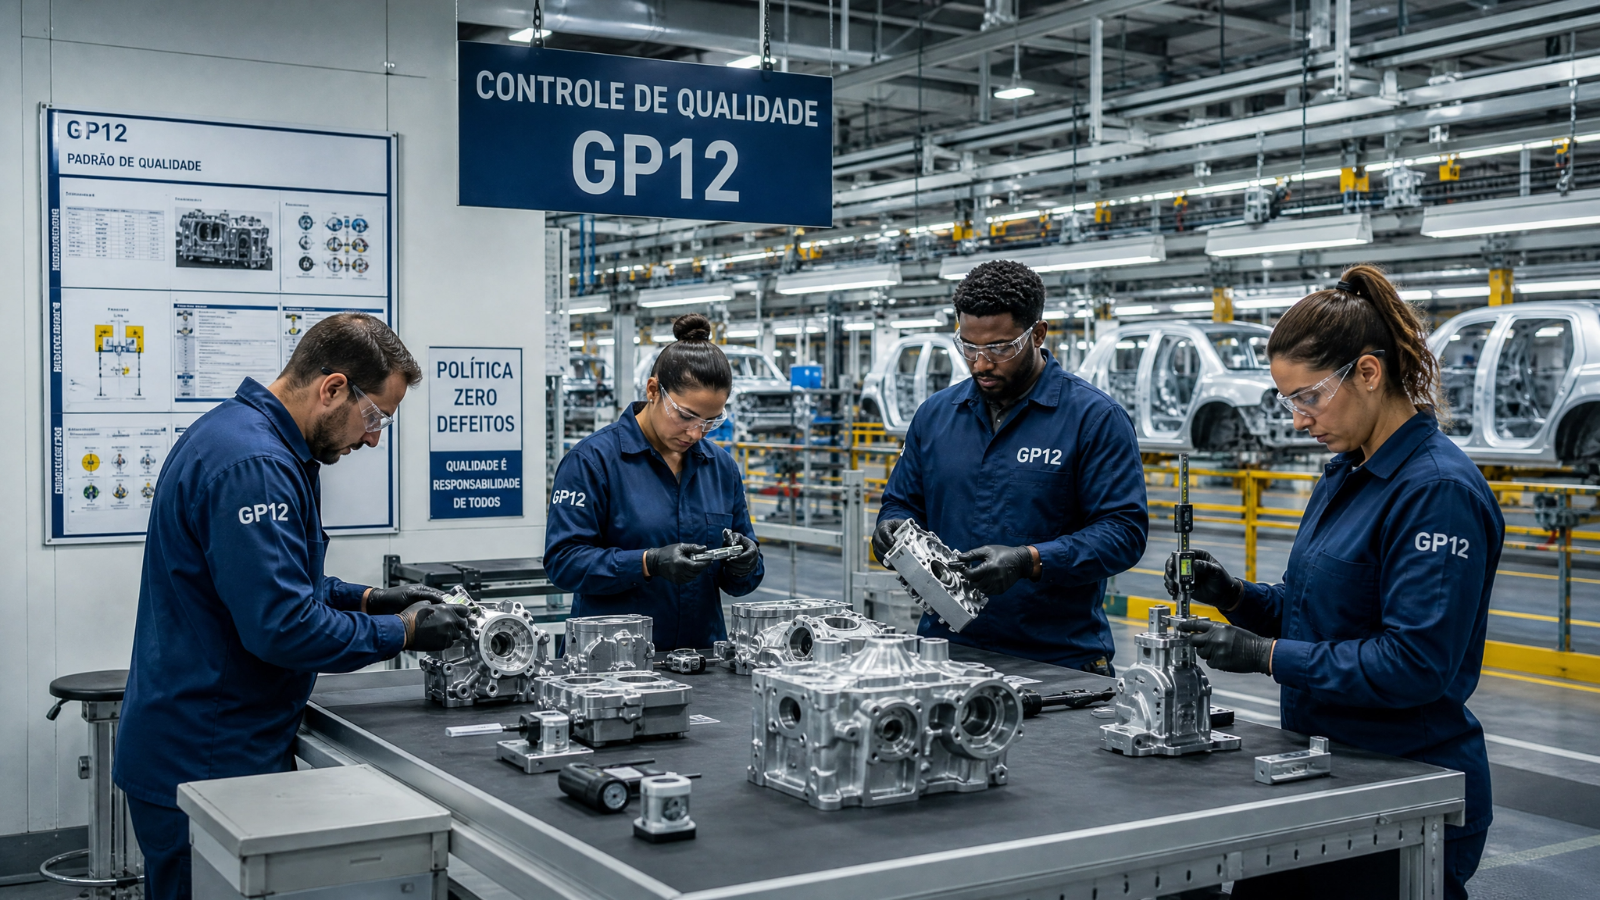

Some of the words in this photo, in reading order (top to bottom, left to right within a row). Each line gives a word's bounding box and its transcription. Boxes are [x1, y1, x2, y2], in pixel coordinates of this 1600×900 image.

[476, 70, 625, 110] CONTROLE
[634, 83, 668, 114] DE
[677, 88, 819, 128] QUALIDADE
[67, 120, 127, 143] GP12
[67, 153, 115, 166] PADRÃO
[120, 156, 134, 167] DE
[139, 157, 202, 171] QUALIDADE
[572, 130, 740, 202] GP12
[437, 357, 513, 379] POLÍTICA
[454, 388, 497, 406] ZERO
[437, 415, 515, 433] DEFEITOS
[446, 460, 499, 472] QUALIDADE
[501, 458, 507, 471] É
[1016, 447, 1063, 466] GP12
[433, 478, 521, 490] RESPONSABILIDADE
[453, 498, 466, 509] DE
[468, 497, 501, 508] TODOS
[552, 489, 586, 507] GP12
[238, 502, 289, 525] GP12
[1414, 531, 1470, 559] GP12
